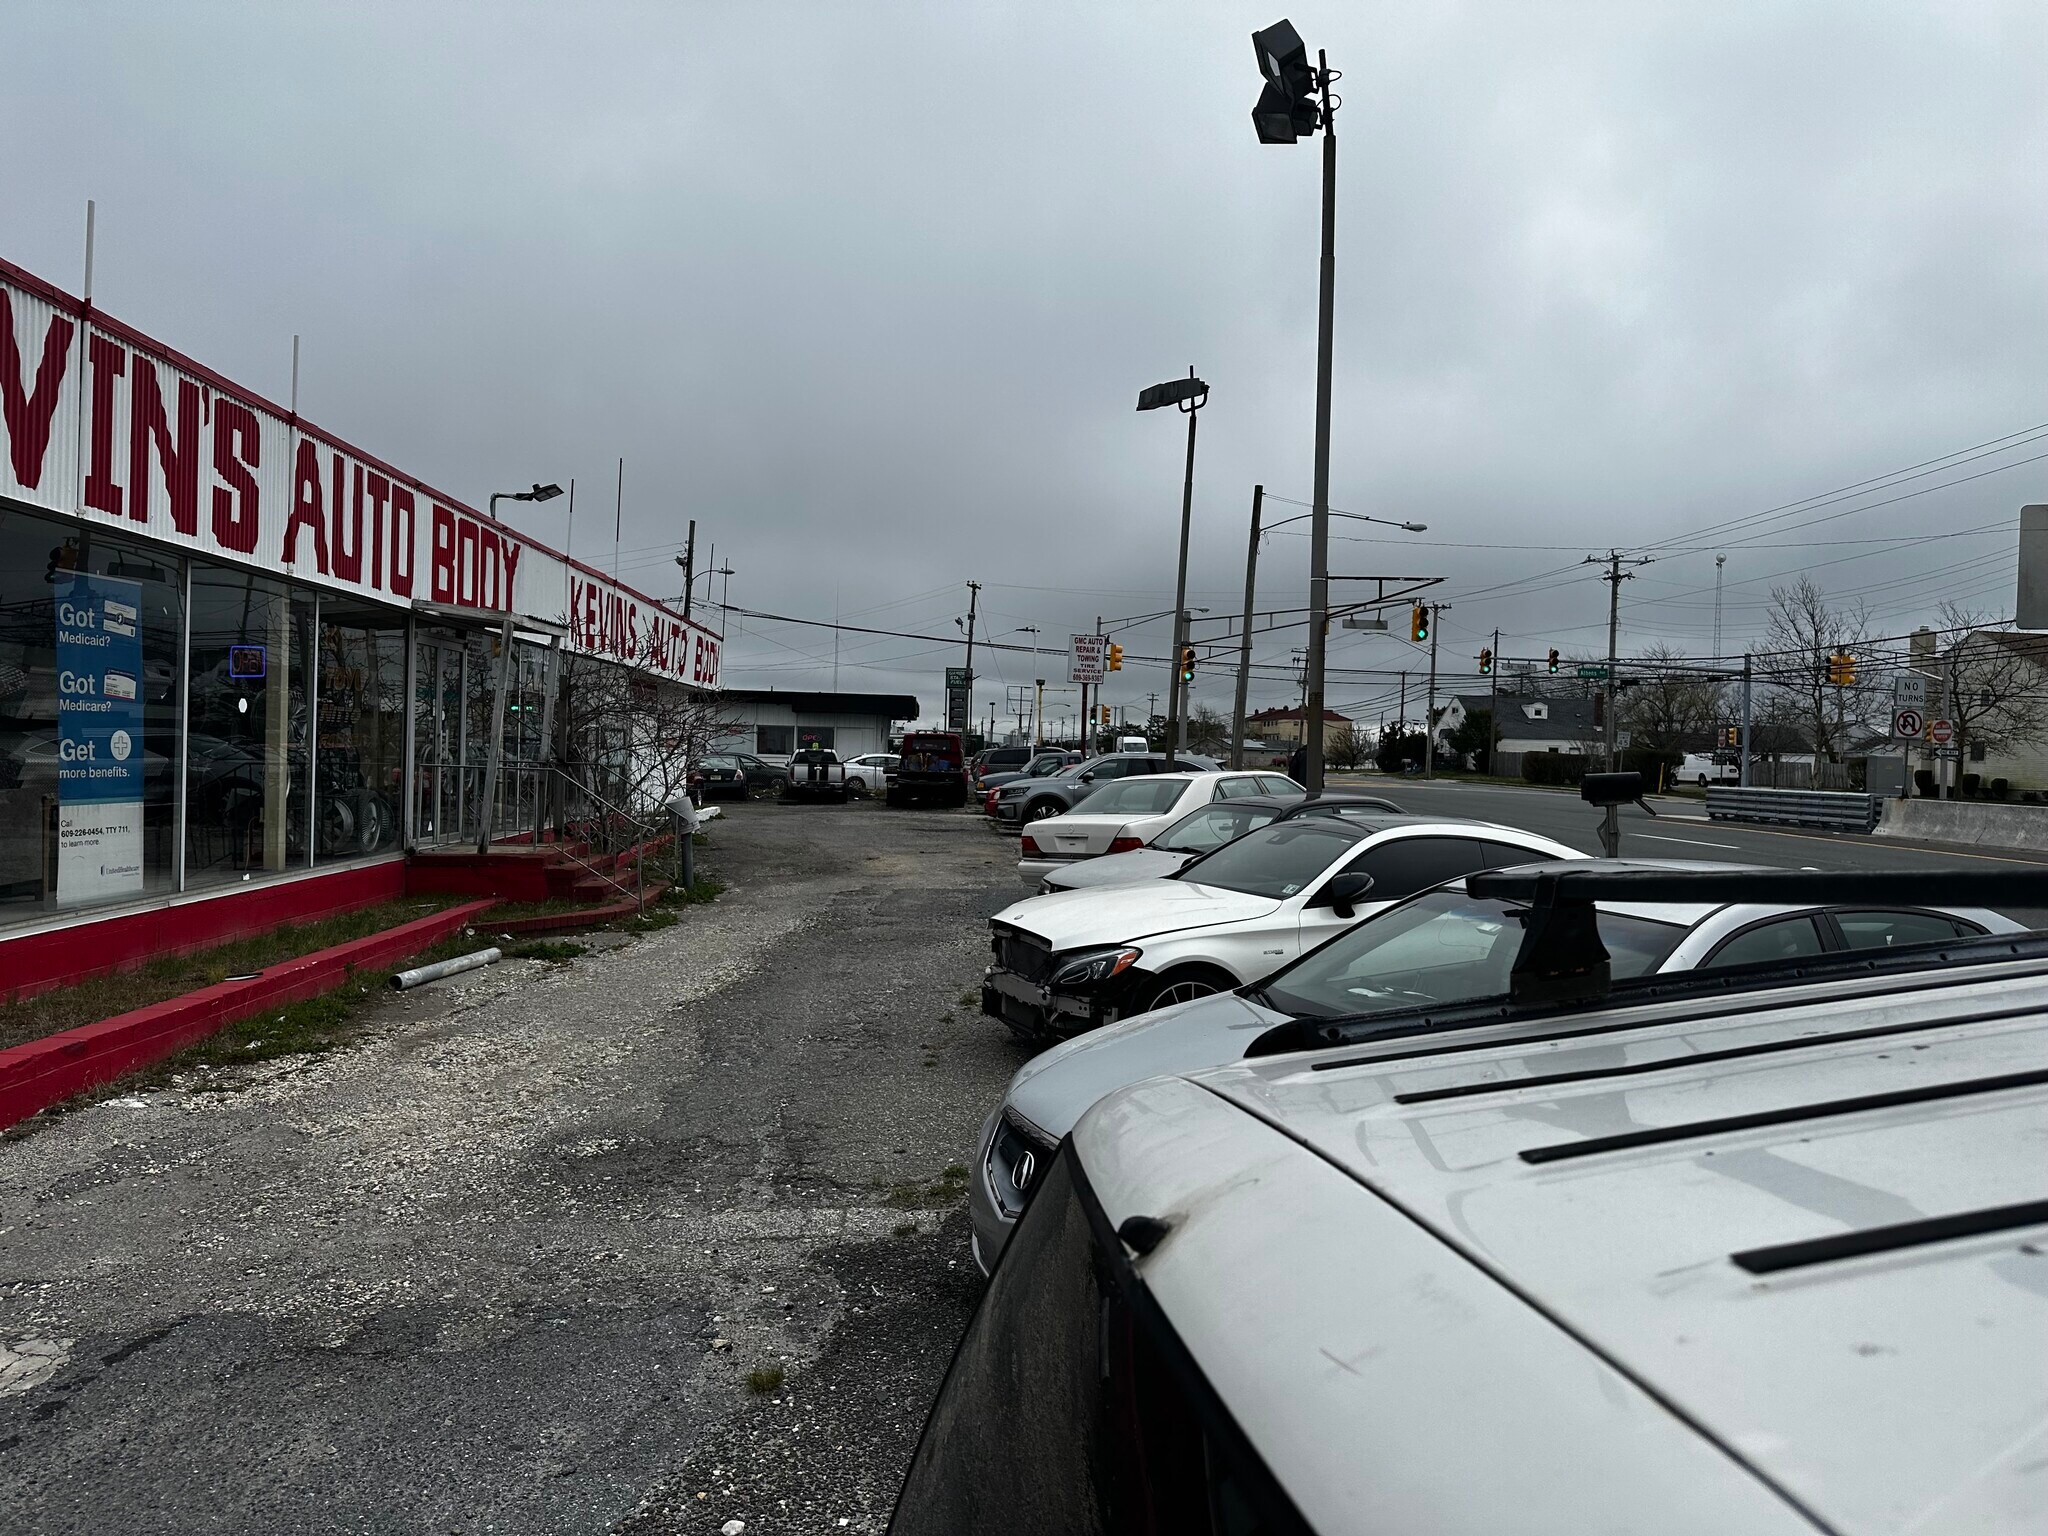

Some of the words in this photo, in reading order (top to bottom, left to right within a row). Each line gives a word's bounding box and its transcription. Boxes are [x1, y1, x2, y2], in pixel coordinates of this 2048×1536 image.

[0, 287, 261, 555] VIN'S
[281, 437, 415, 599] AUTO
[431, 503, 521, 612] BODY
[59, 602, 96, 628] Got
[570, 575, 637, 660] KEVINS
[651, 615, 690, 677] AUTO
[694, 635, 720, 686] BODY
[59, 630, 111, 647] Medicaid?
[1074, 637, 1087, 645] GMC
[1088, 638, 1103, 646] AUTO
[59, 670, 96, 695] Got
[1904, 682, 1919, 691] NO
[1898, 694, 1924, 703] TURNS
[59, 699, 112, 712] Medicare?
[59, 738, 96, 762] Get
[59, 769, 87, 779] more
[88, 766, 130, 778] benefits.
[61, 820, 73, 828] Call
[105, 827, 117, 835] TTY
[61, 841, 68, 849] to
[69, 839, 84, 848] learn
